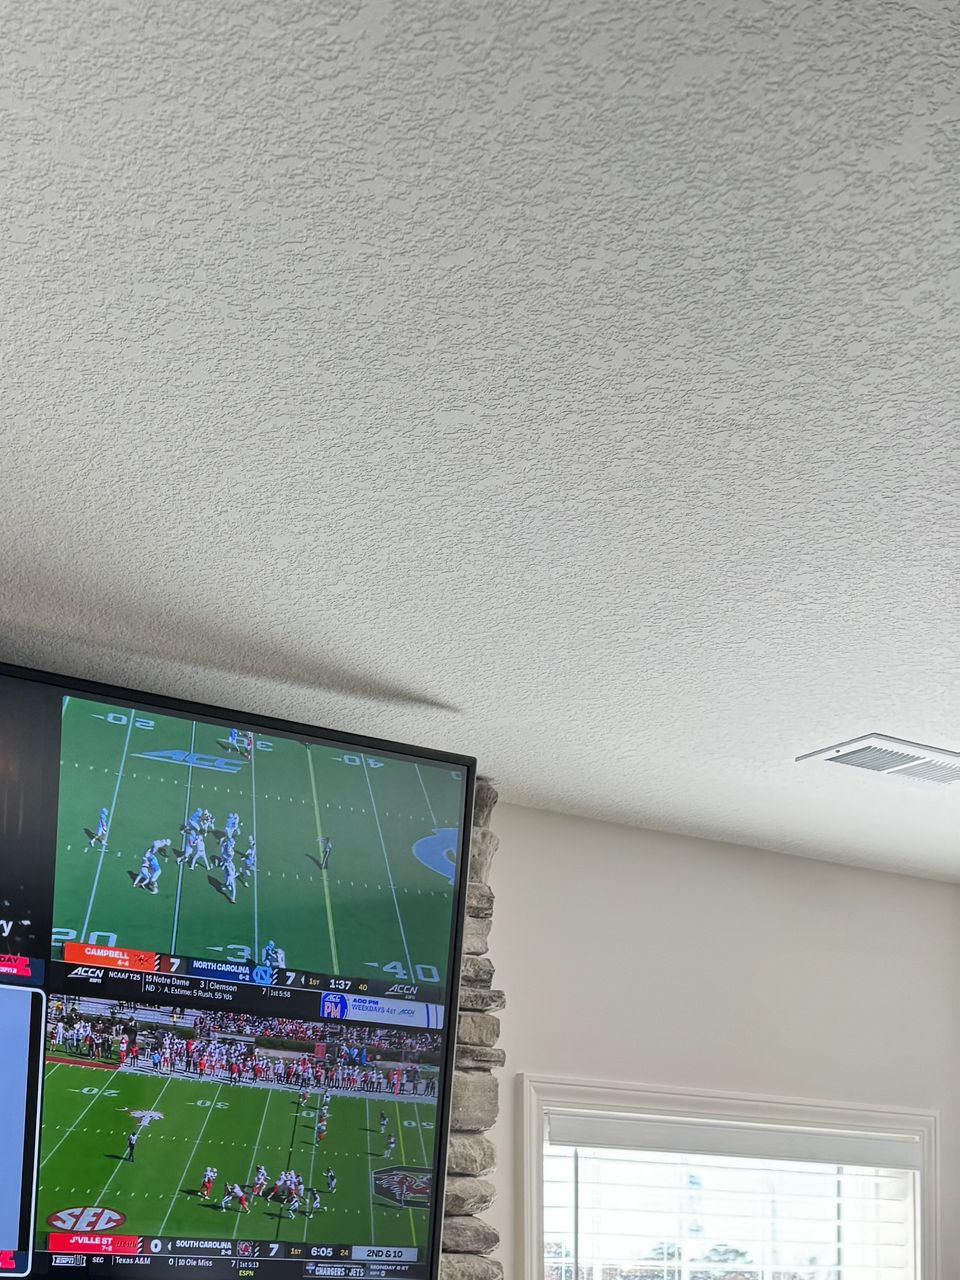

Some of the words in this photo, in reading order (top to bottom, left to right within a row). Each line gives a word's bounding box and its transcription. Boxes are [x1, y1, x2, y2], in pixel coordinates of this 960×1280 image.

[85, 947, 129, 960] CAMPBELL
[170, 958, 180, 972] 7
[193, 960, 217, 970] NORTH
[217, 962, 250, 974] CAROLINA
[67, 967, 104, 978] ACCN
[108, 971, 128, 980] NCAAF
[129, 973, 141, 981] T25
[285, 971, 296, 985] 7
[145, 974, 152, 982] 15
[153, 975, 170, 985] Notre
[172, 978, 190, 987] Dame
[200, 980, 205, 988] 3
[330, 979, 352, 991] 1:37
[358, 983, 368, 991] 40
[145, 984, 155, 992] ND
[193, 989, 198, 997] 5
[209, 981, 238, 992] Clemson
[262, 987, 267, 995] 7
[385, 983, 418, 995] ACCN
[270, 988, 279, 997] 1st
[323, 1002, 340, 1018] PM
[352, 1003, 385, 1014] WEEKDAYS
[53, 1206, 121, 1232] SEC
[150, 1239, 162, 1252] 0
[176, 1240, 198, 1248] SOUTH
[199, 1241, 232, 1250] CAROLINA
[269, 1243, 279, 1256] 7
[311, 1247, 333, 1257] 6:05
[366, 1249, 384, 1258] 2ND
[384, 1250, 392, 1258] &
[393, 1250, 403, 1258] 10
[115, 1256, 133, 1264] Texas
[134, 1257, 151, 1265] A&M
[168, 1258, 174, 1266] 0
[186, 1258, 197, 1267] Ole
[198, 1259, 213, 1267] Miss
[315, 1267, 345, 1276] CHARGERS
[349, 1268, 364, 1277] JETS
